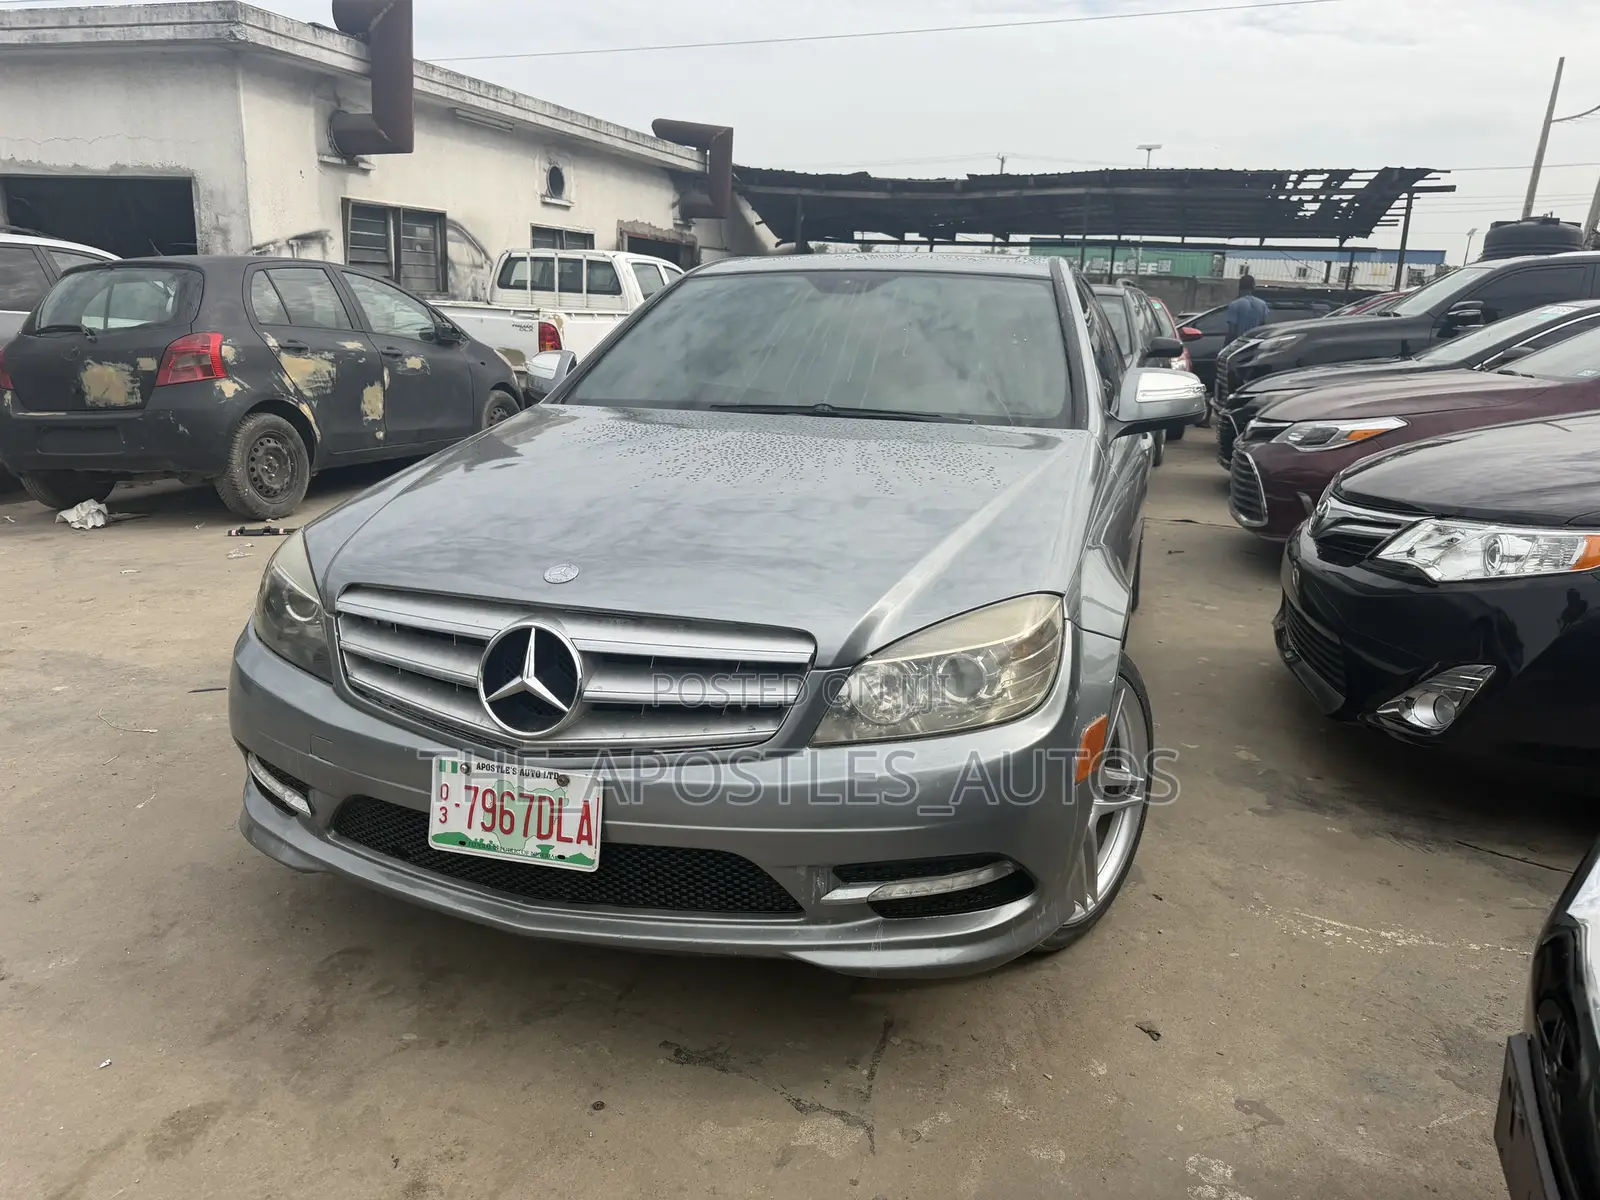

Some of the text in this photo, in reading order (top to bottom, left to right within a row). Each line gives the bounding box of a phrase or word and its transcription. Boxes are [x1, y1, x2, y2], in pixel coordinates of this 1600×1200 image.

[476, 761, 560, 781] APOSTLE'S AUTO LTD
